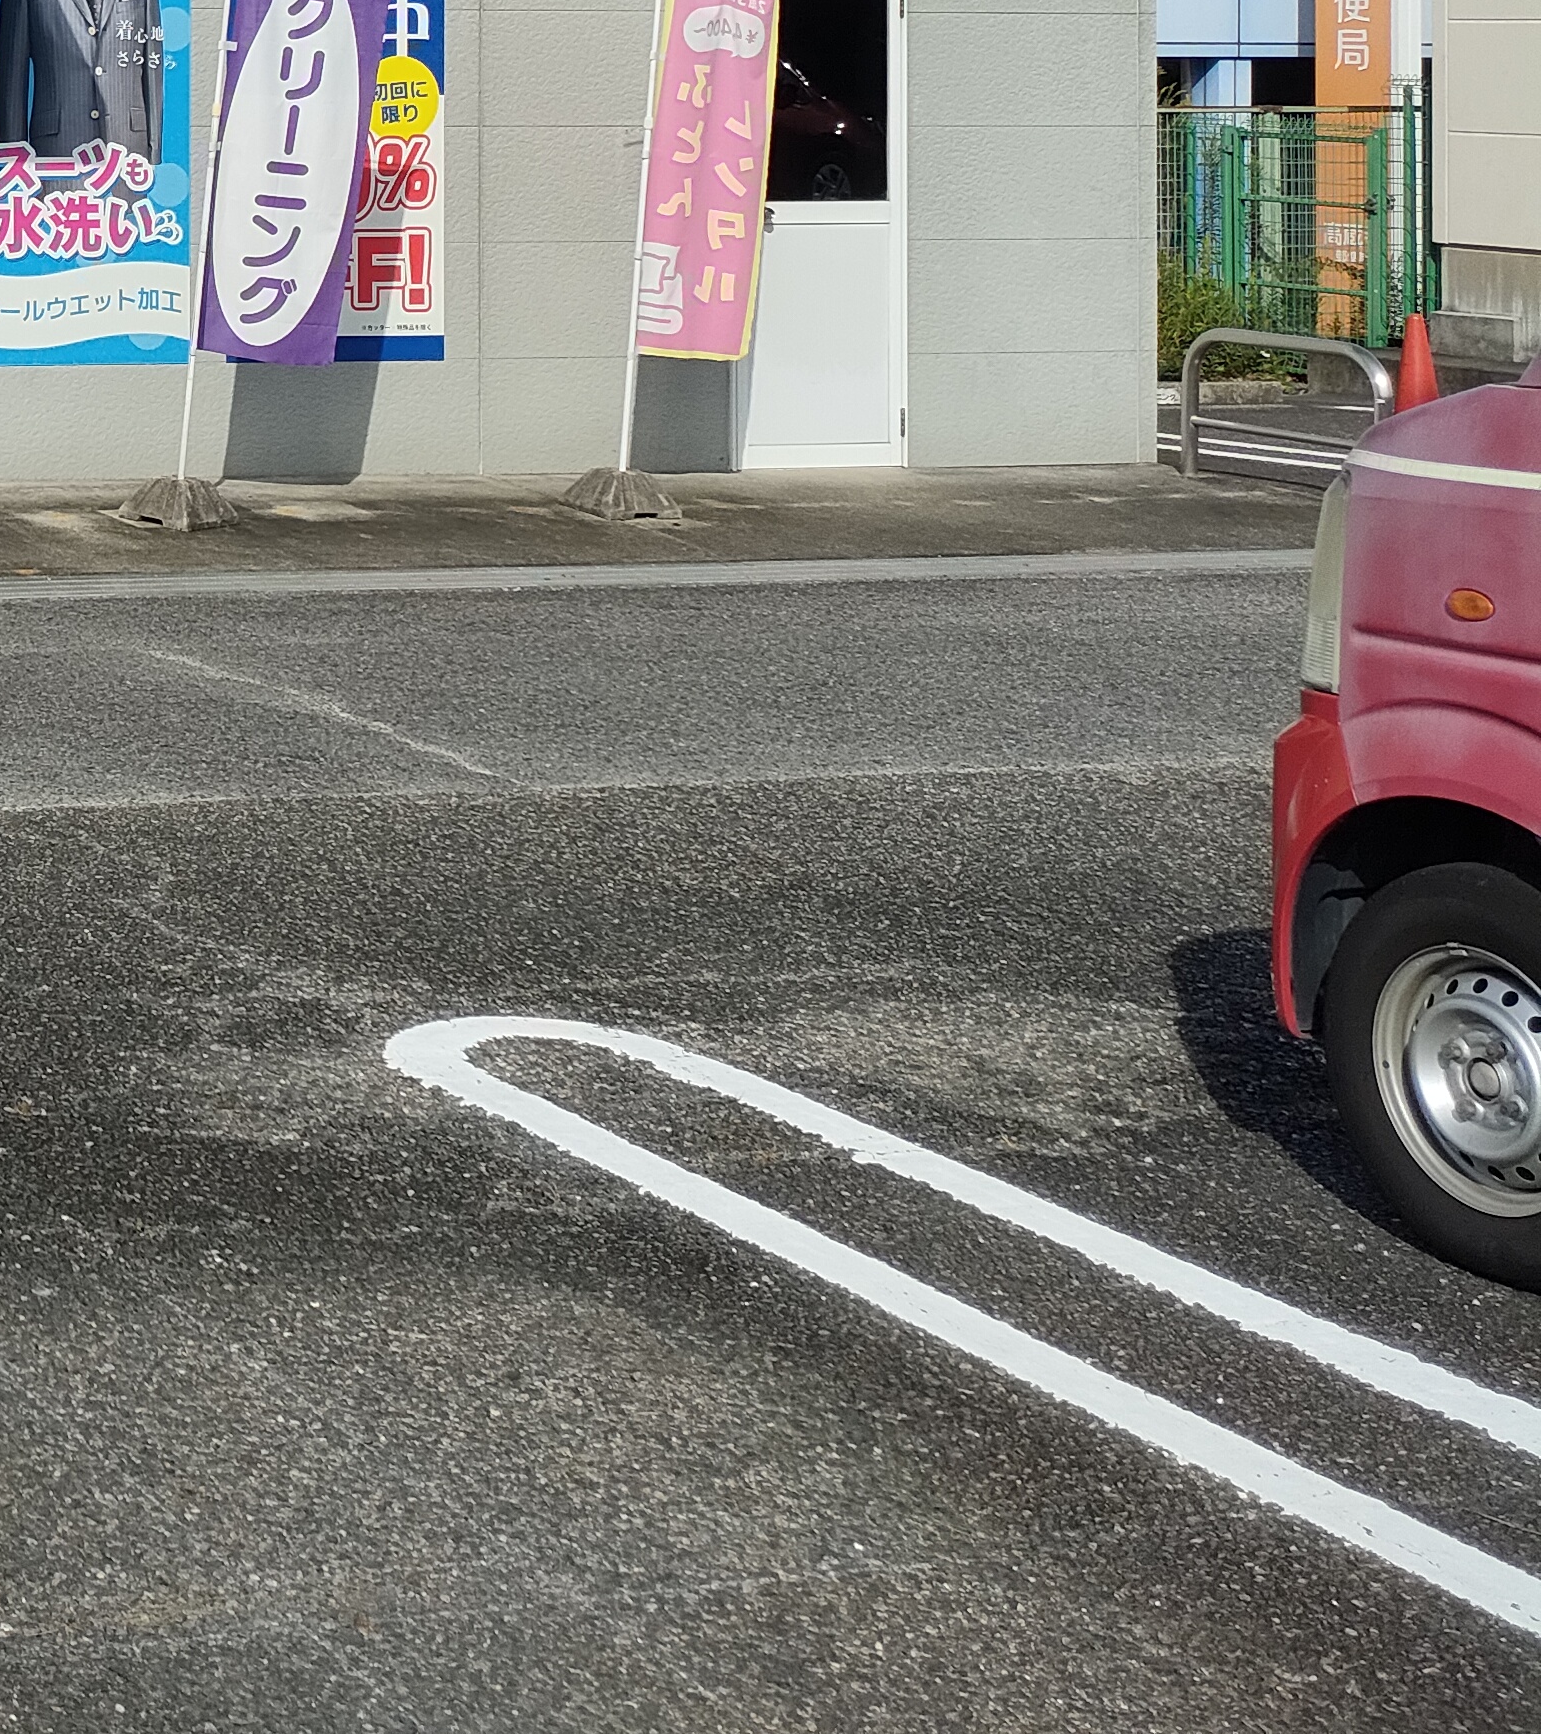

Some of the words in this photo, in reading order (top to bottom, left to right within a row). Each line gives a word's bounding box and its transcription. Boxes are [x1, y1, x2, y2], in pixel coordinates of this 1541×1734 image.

[115, 19, 165, 44] 着心地
[116, 49, 178, 70] さらさら
[380, 104, 419, 124] 限り
[345, 229, 429, 309] F!
